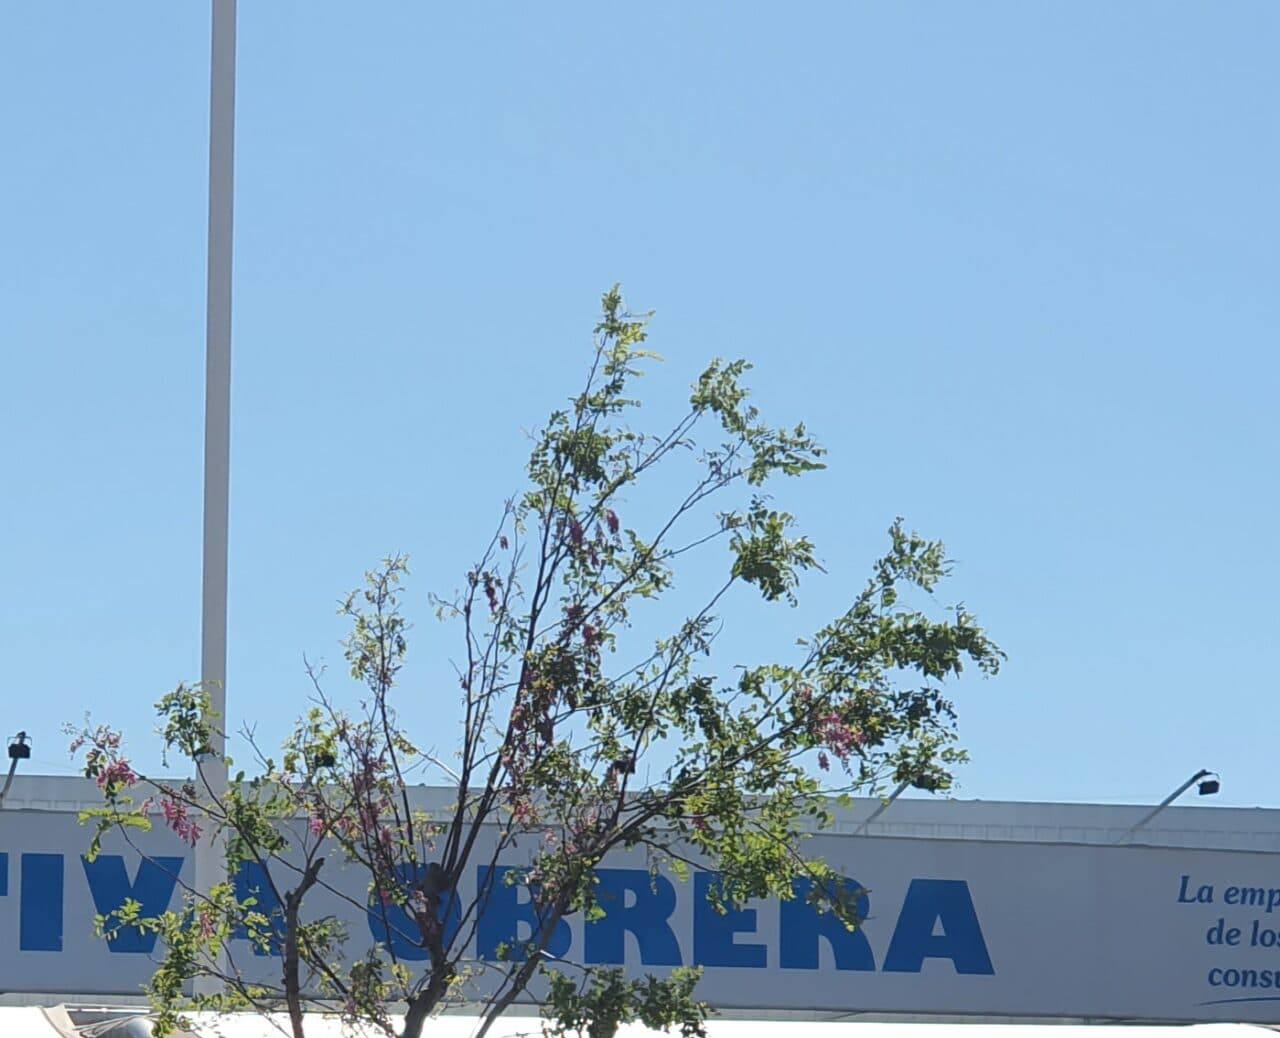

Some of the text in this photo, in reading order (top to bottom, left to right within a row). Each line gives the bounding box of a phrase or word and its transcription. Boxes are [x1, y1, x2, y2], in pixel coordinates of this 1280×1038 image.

[1178, 875, 1214, 904] La
[367, 861, 995, 975] OBRERA
[1206, 918, 1242, 946] de
